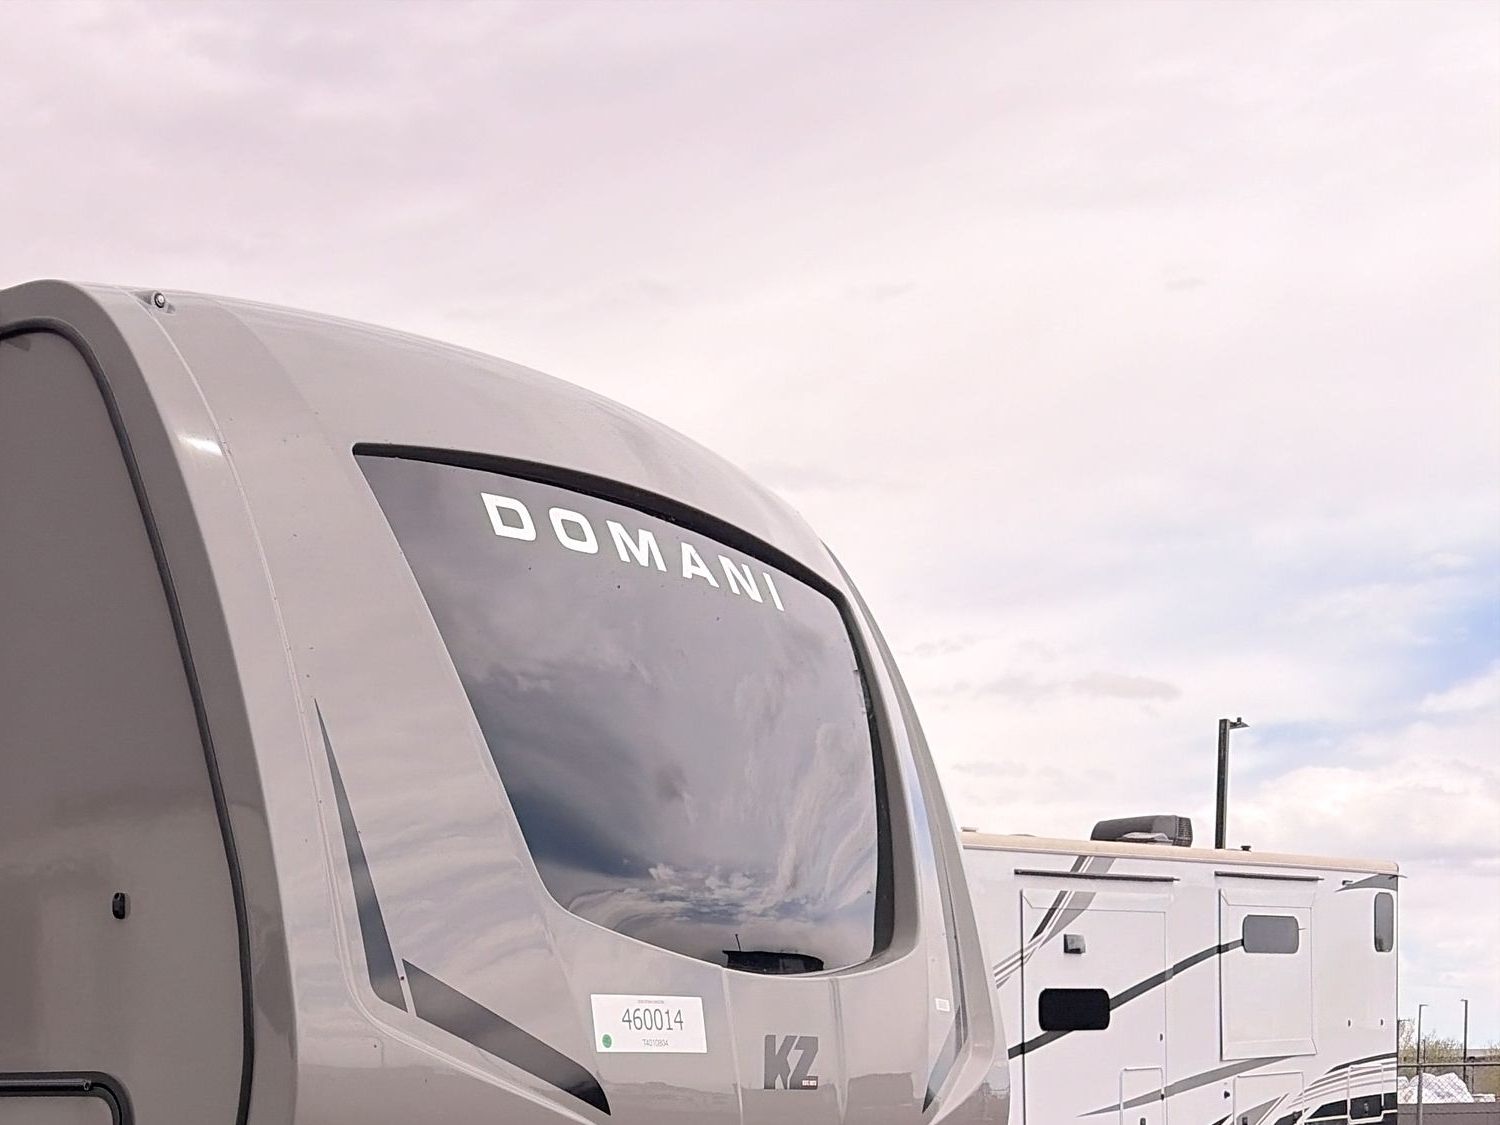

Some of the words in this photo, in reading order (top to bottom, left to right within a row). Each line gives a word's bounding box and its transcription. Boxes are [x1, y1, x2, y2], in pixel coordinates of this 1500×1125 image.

[480, 492, 785, 612] DOMANI
[621, 1008, 684, 1031] 460014
[763, 1034, 819, 1090] KZ
